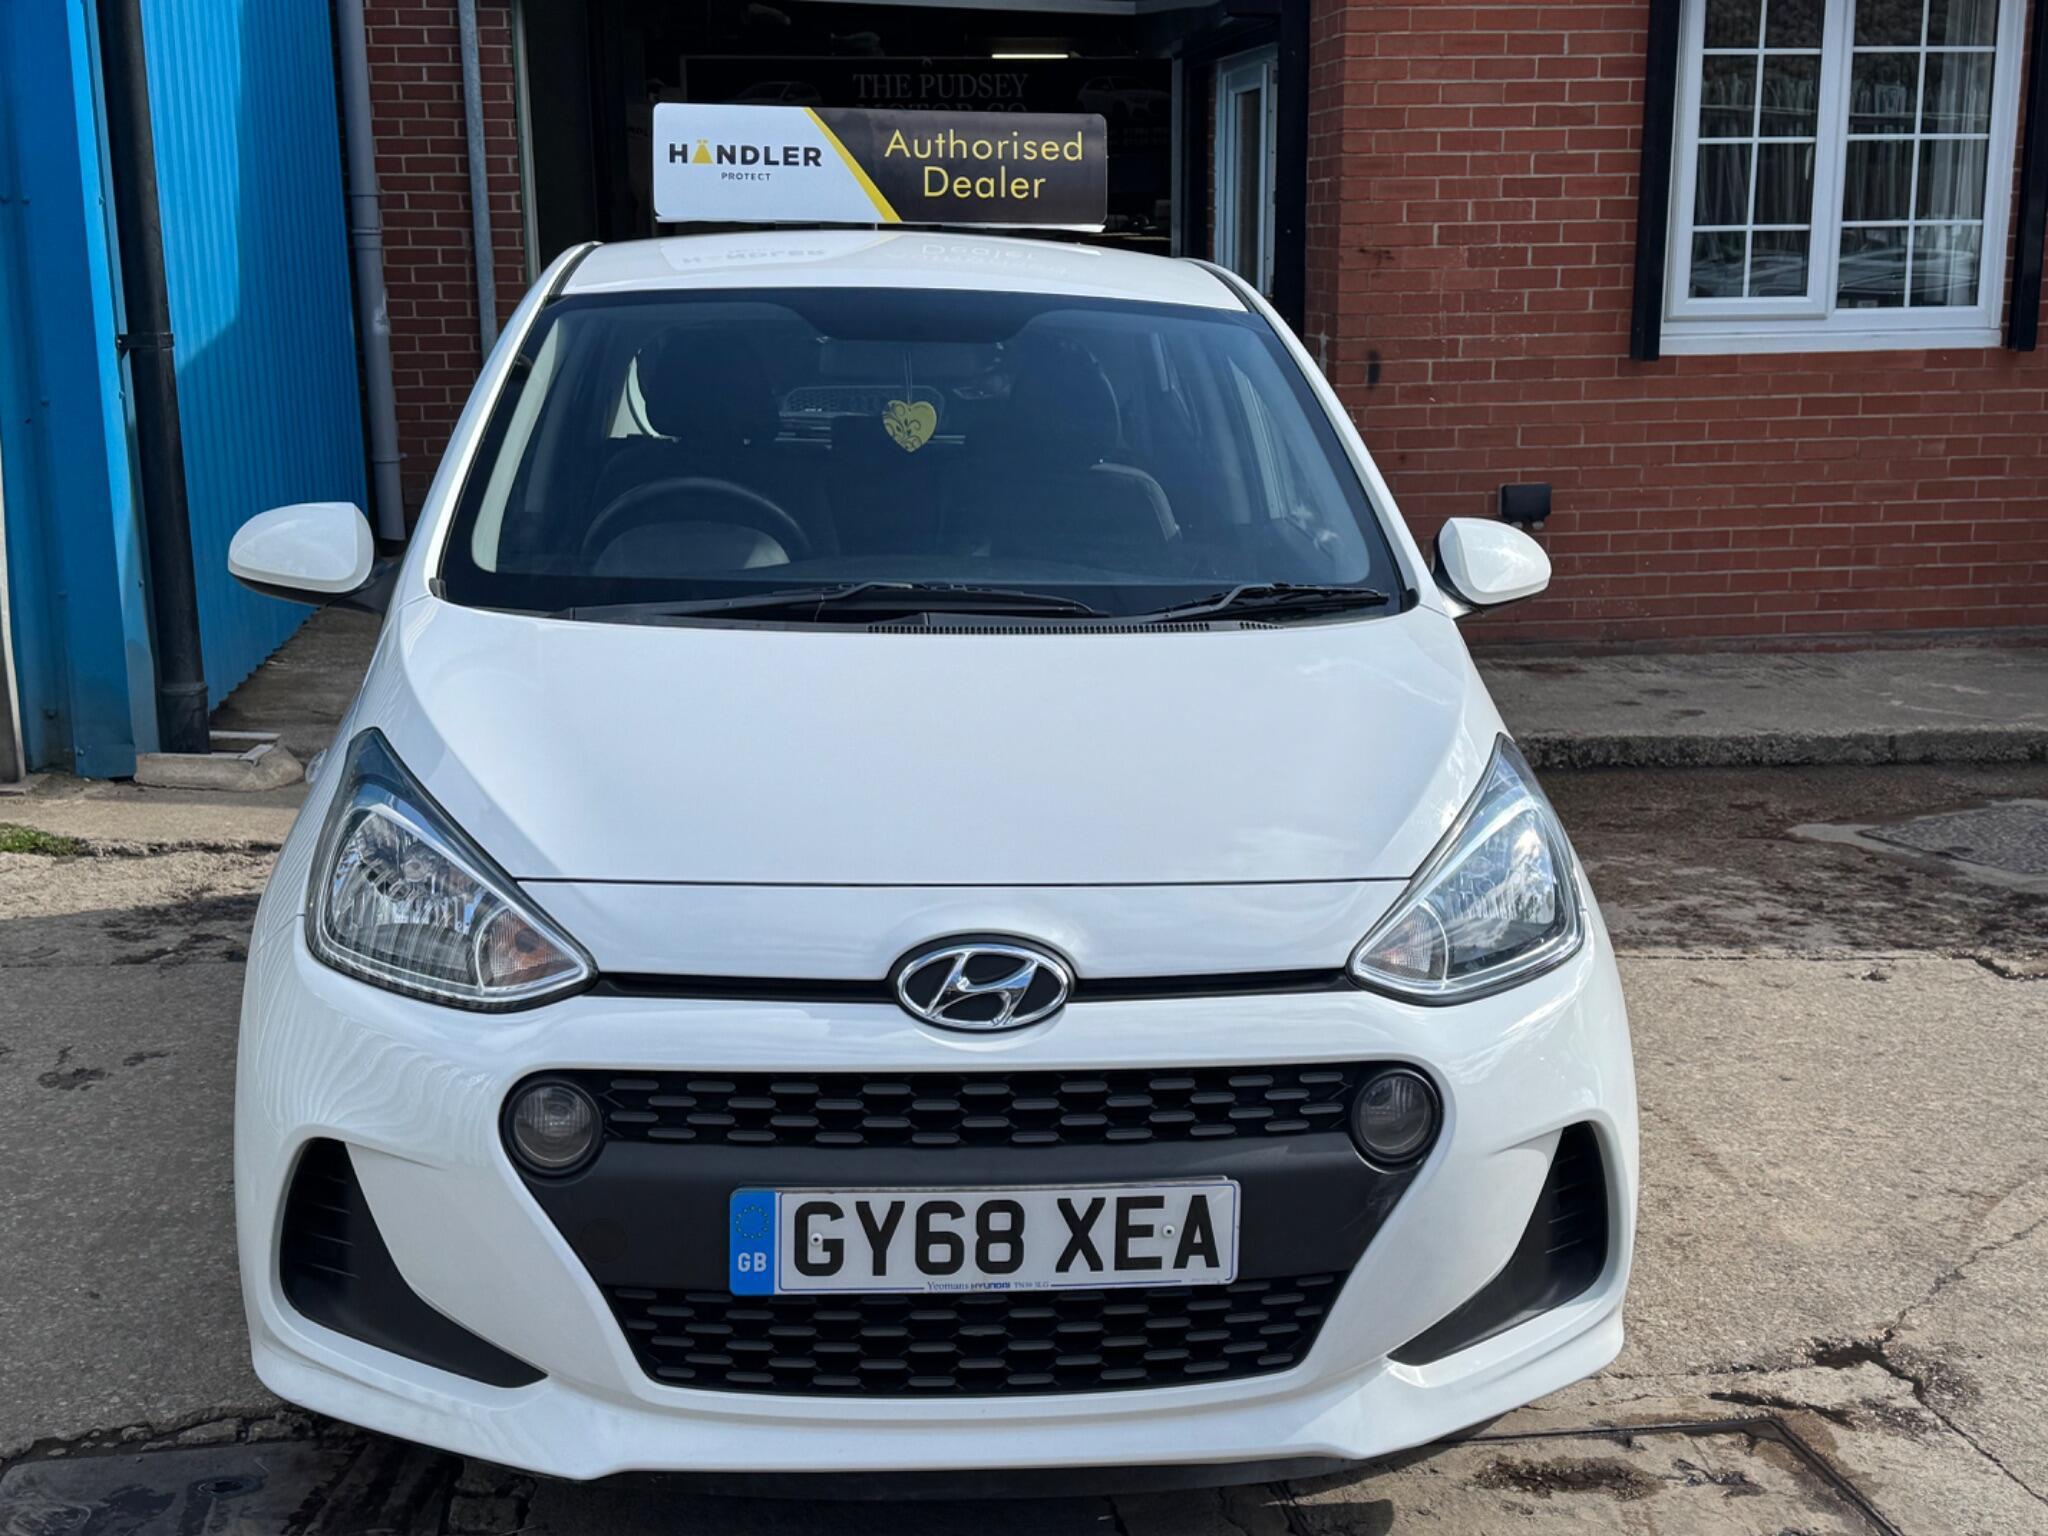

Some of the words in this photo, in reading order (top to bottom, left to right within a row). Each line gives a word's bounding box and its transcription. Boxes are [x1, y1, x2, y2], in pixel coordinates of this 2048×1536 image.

[853, 73, 912, 99] THE
[918, 72, 1029, 99] PUDSEY
[885, 129, 1084, 161] Authorised
[720, 171, 772, 182] PROTECT
[924, 165, 1046, 199] Dealer
[793, 1199, 1026, 1277] GY68
[1055, 1194, 1221, 1273] XEA
[737, 1252, 768, 1273] GB
[927, 1281, 969, 1291] Yeomans
[970, 1281, 1011, 1289] HYUNDAI
